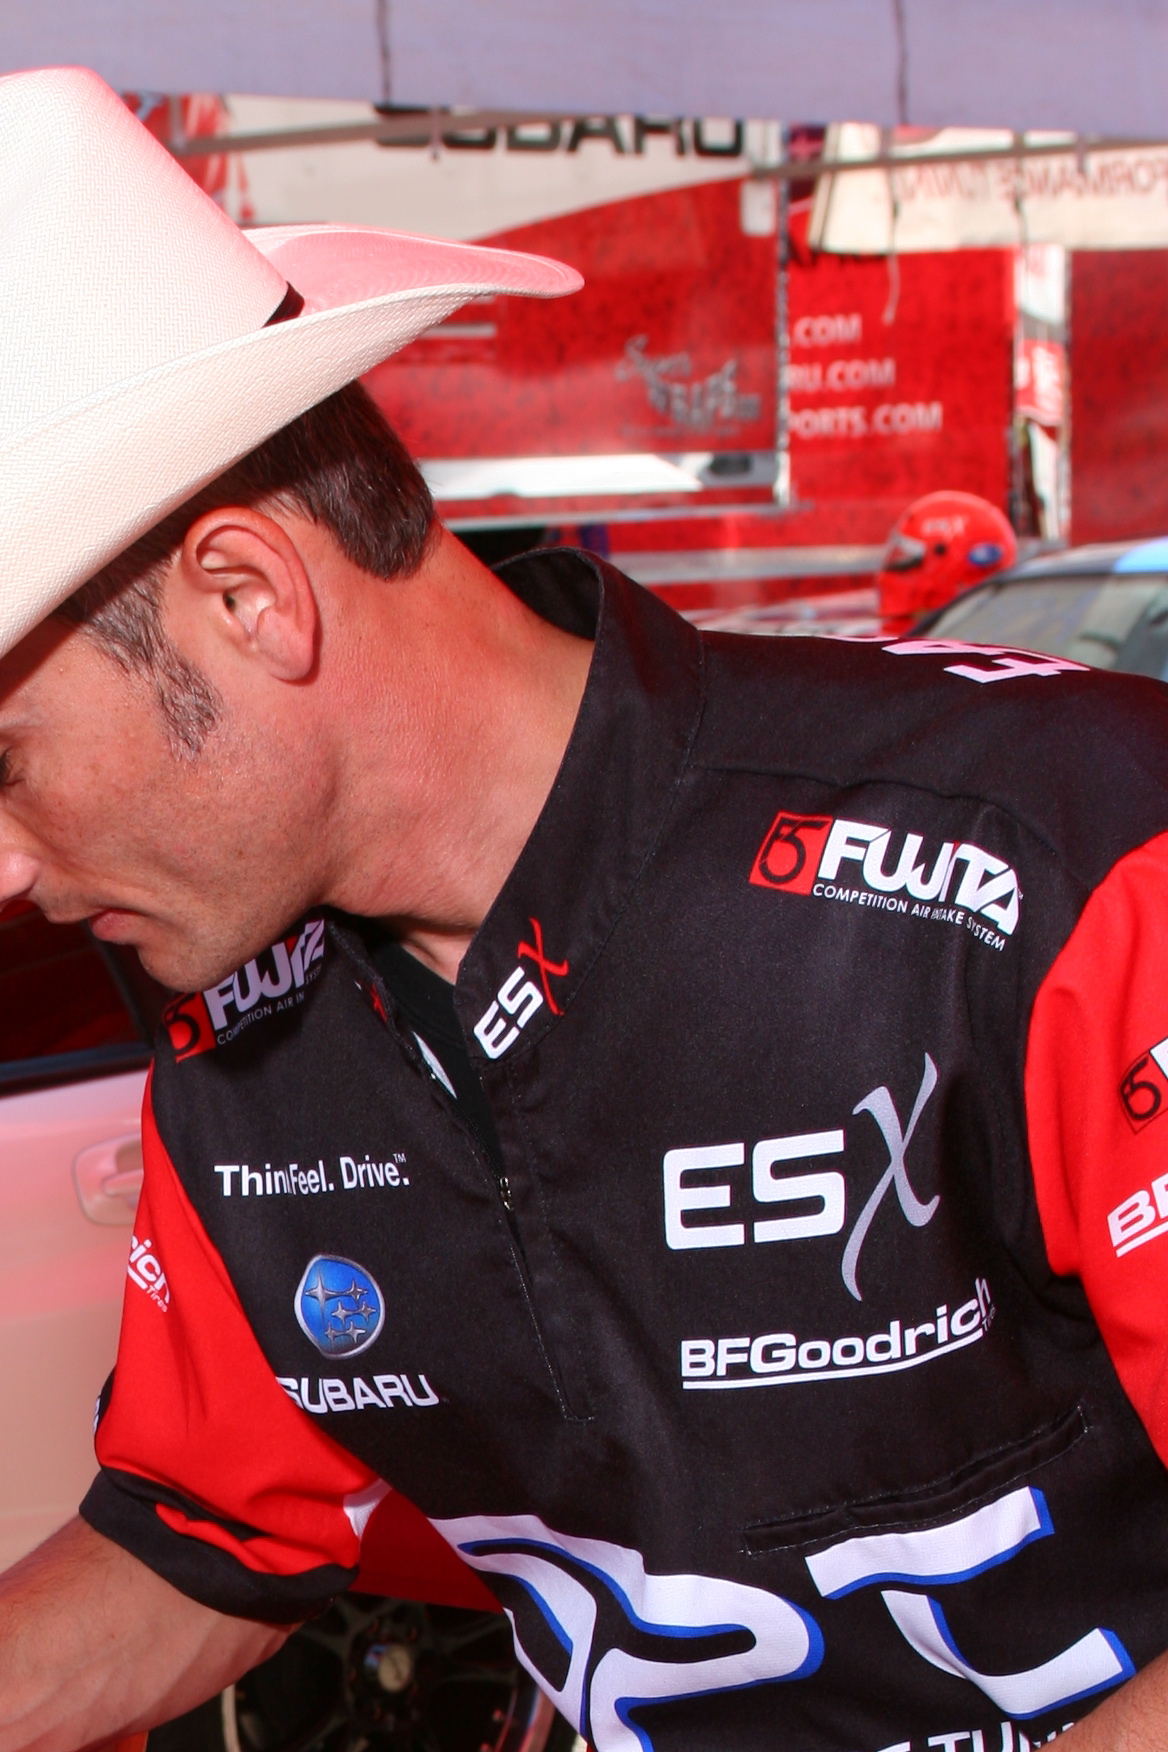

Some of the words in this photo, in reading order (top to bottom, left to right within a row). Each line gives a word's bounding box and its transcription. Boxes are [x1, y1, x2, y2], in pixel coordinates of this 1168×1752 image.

[812, 883, 908, 914] COMPETITION
[910, 903, 931, 920] AIR
[966, 916, 1006, 951] SYSTEM
[680, 1276, 992, 1378] BFGoodrich
